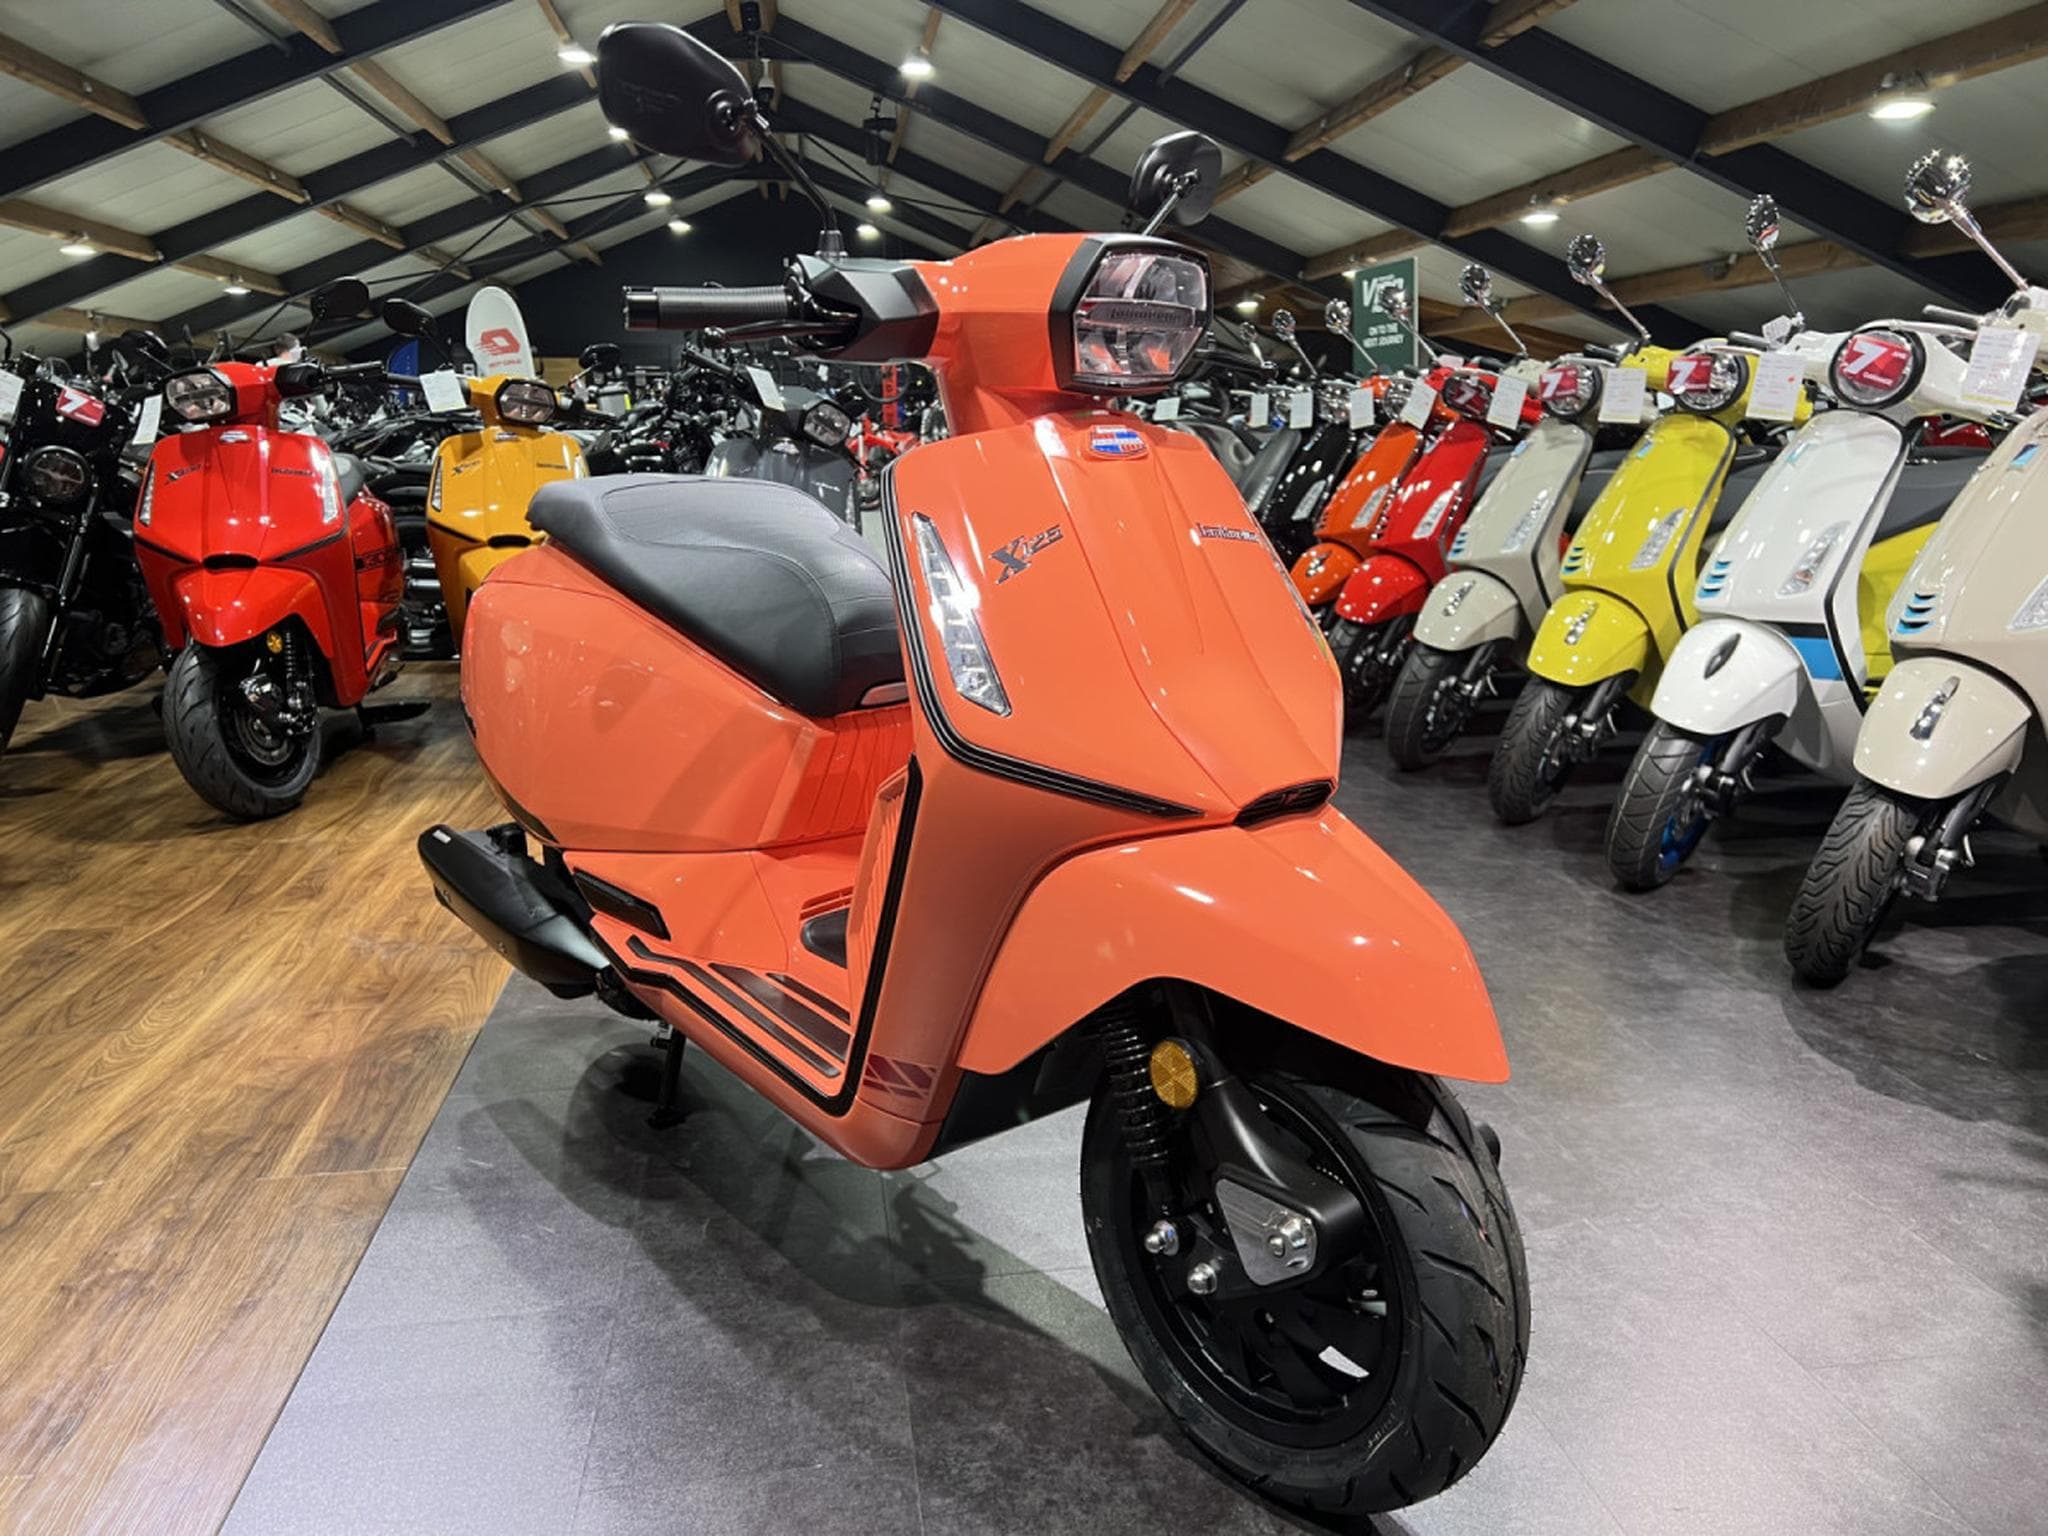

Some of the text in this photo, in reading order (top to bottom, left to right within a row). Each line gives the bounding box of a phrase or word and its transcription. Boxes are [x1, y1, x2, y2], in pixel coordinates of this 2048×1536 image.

[1843, 340, 1888, 375] 7
[1542, 372, 1563, 398] 7
[1669, 360, 1698, 393] 7
[60, 389, 89, 413] 7
[990, 524, 1064, 585] X125
